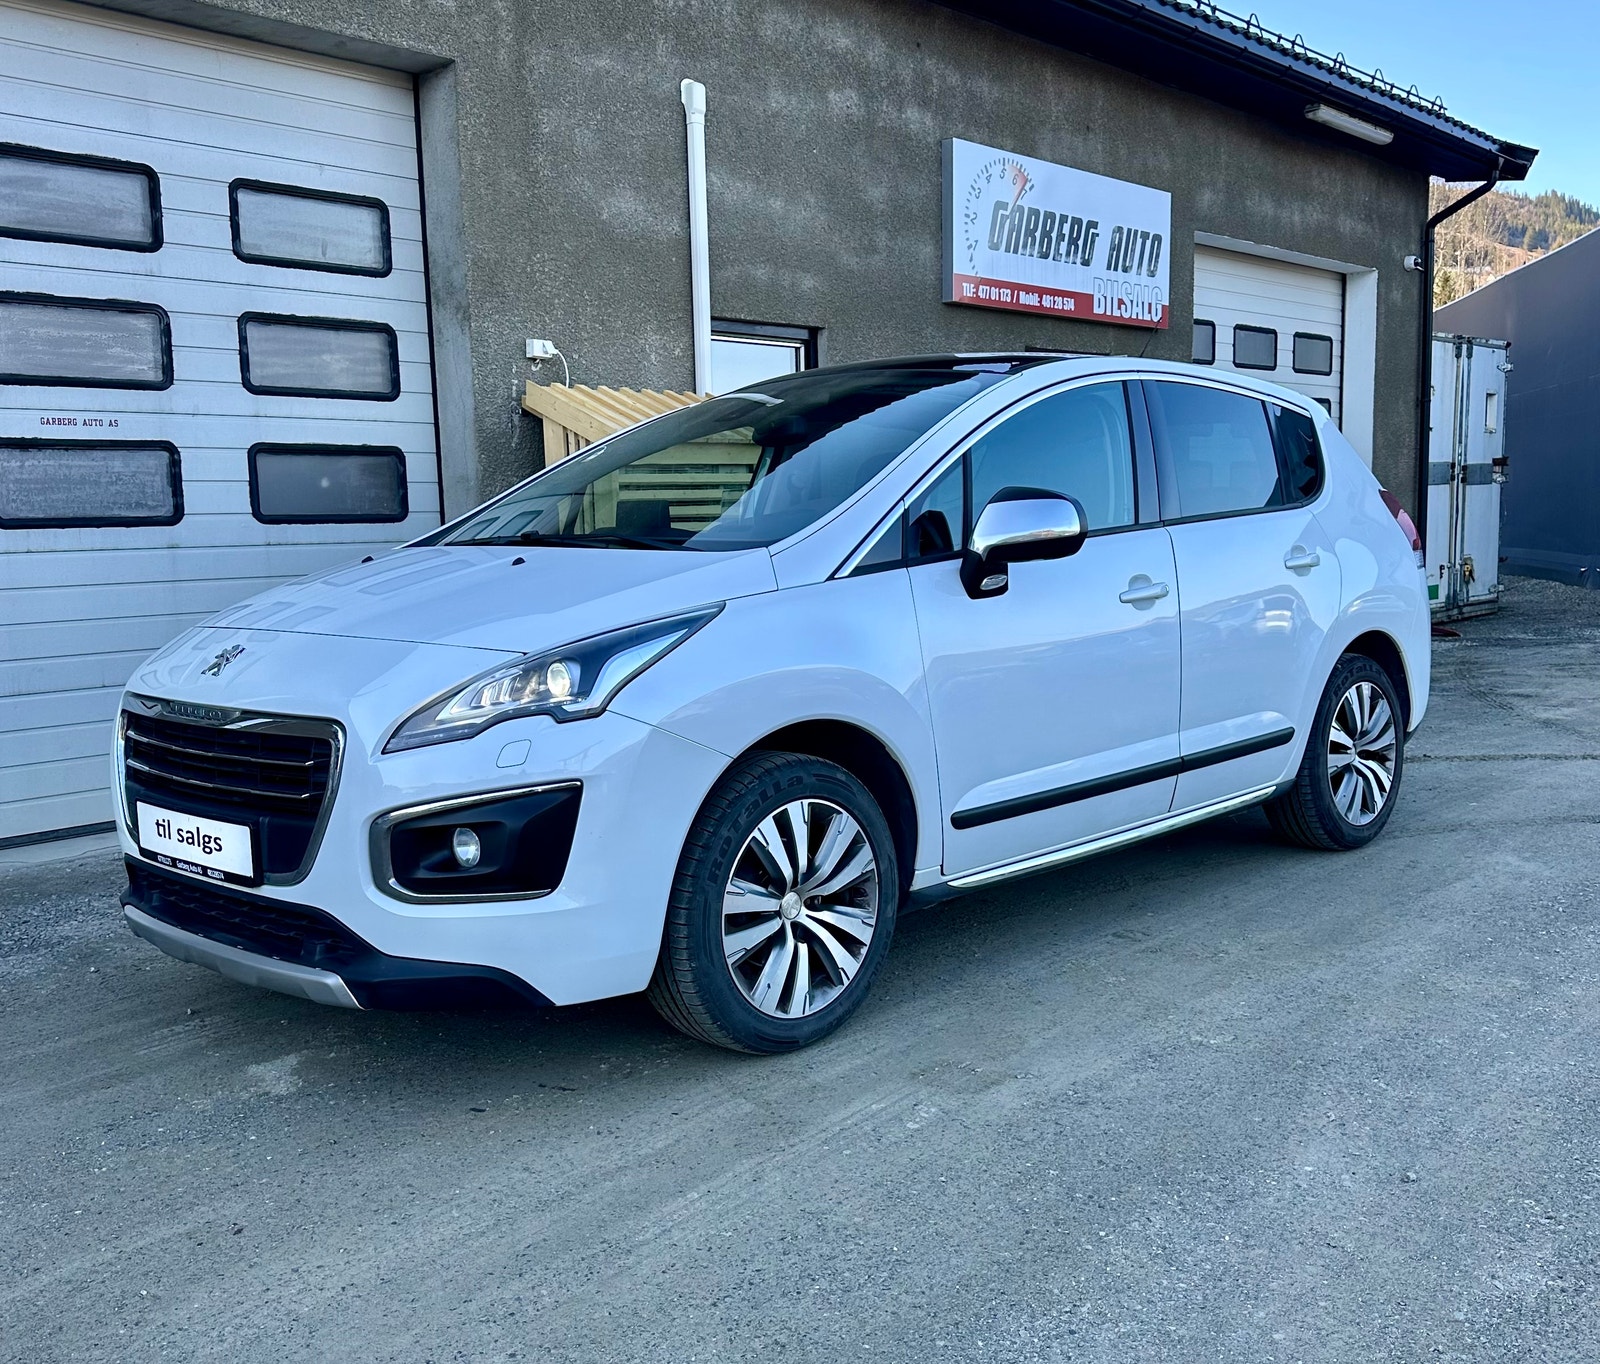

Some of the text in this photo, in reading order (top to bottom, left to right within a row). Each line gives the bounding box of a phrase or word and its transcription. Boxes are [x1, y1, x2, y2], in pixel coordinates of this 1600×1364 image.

[970, 212, 978, 225] 2
[975, 187, 982, 200] 3
[985, 173, 993, 184] 4
[1000, 168, 1007, 179] 5
[1012, 174, 1019, 186] 6
[1020, 189, 1028, 200] 7
[987, 200, 1163, 278] GARBERG AUTO
[962, 282, 976, 298] TLF:
[1019, 291, 1041, 307] Mobil:
[1093, 277, 1163, 323] BILSALG
[40, 417, 119, 428] GARBERG AUTO AS
[155, 819, 223, 855] til salgs
